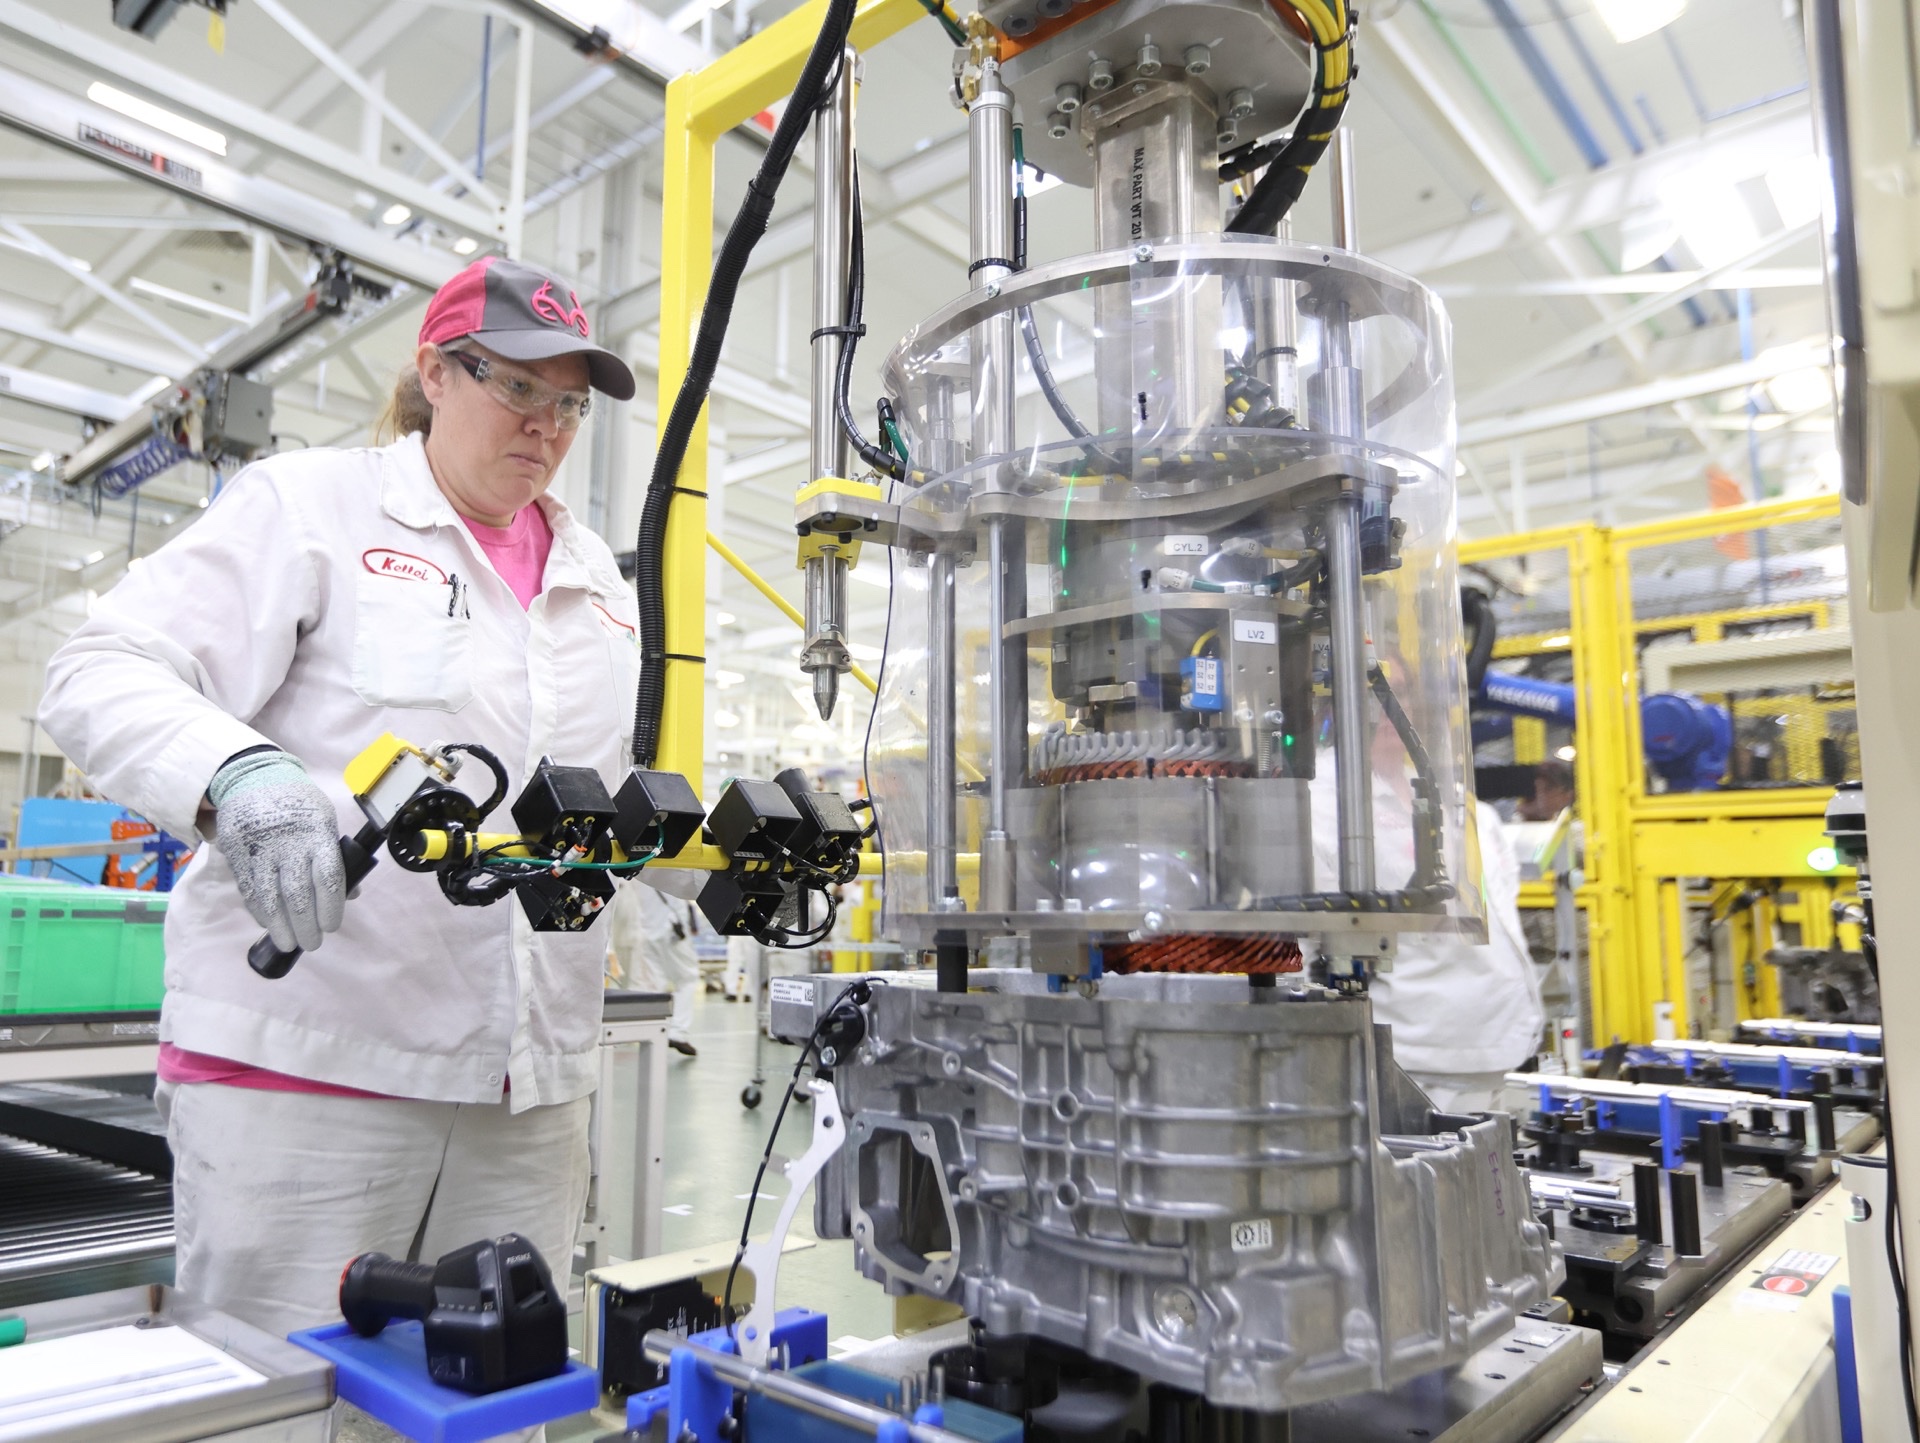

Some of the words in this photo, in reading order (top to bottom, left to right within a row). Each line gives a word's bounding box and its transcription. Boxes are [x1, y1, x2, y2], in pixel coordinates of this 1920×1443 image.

[1134, 147, 1145, 173] MAX
[1132, 174, 1143, 200] PART
[1130, 201, 1142, 219] WT
[1131, 221, 1142, 235] 20
[1173, 543, 1203, 552] CYL.2
[1247, 630, 1265, 640] LV2
